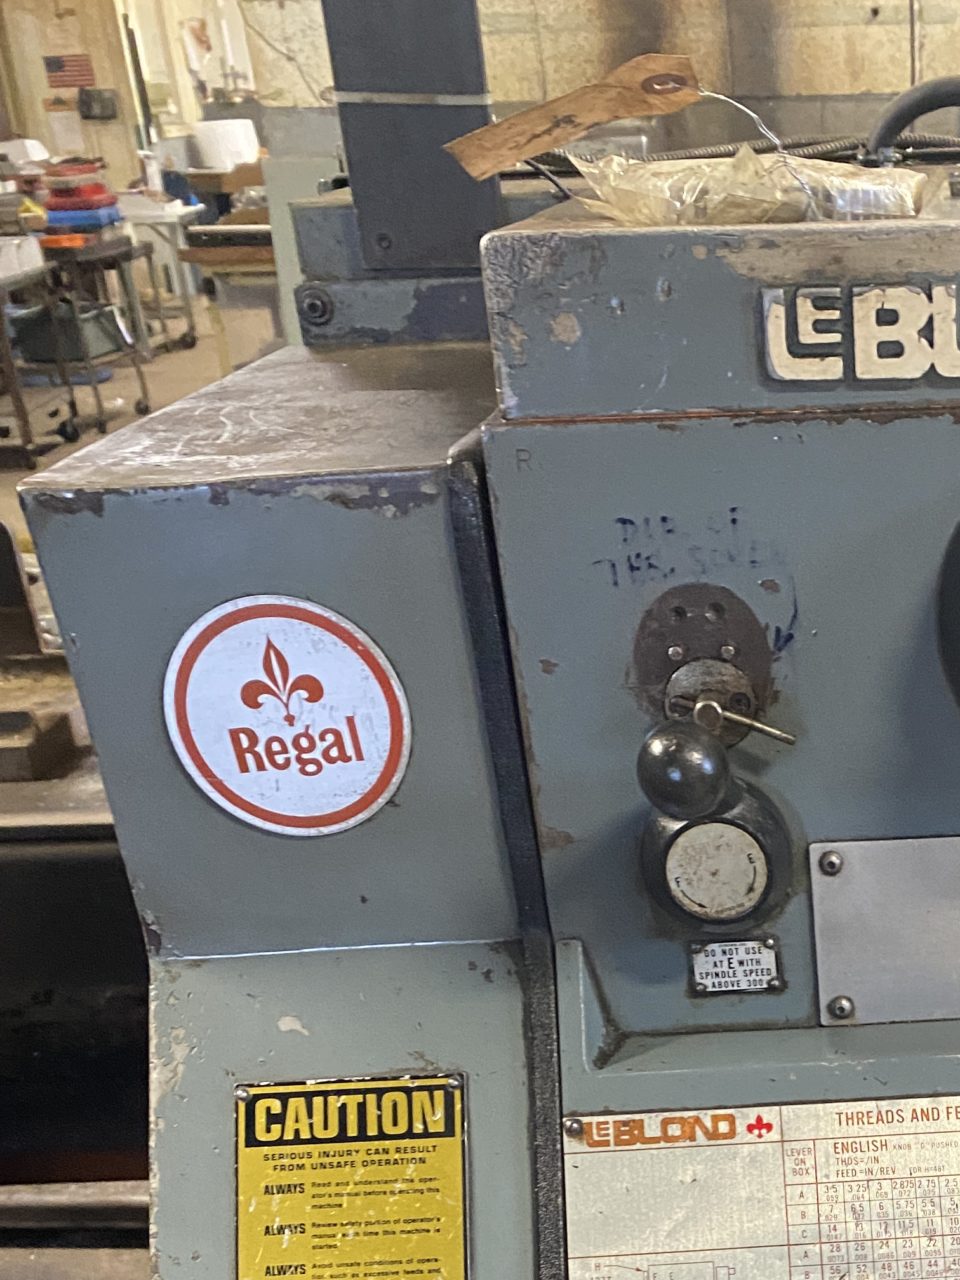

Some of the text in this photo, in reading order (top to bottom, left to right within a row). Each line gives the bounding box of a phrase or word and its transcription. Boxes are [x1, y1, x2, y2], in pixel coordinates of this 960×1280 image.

[516, 449, 532, 472] R
[228, 716, 364, 776] Regal
[704, 946, 762, 957] DO NOT USE
[713, 958, 761, 969] AT E WITH
[699, 968, 772, 980] SPINDLE SPEED
[711, 979, 763, 988] ABOVE 300
[254, 1090, 445, 1142] CAUTION
[836, 1109, 904, 1126] THREADS
[911, 1108, 940, 1122] AND
[786, 1148, 812, 1157] LEVER
[834, 1139, 888, 1154] ENGLISH
[264, 1152, 312, 1161] SERIOUS
[318, 1150, 359, 1158] INJURY
[273, 1158, 426, 1172] FROM UNSAFE OPERATION
[794, 1158, 806, 1166] ON
[792, 1168, 810, 1176] BOX
[264, 1183, 304, 1195] ALWAYS
[264, 1224, 305, 1236] ALWAYS
[830, 1244, 840, 1252] 28
[855, 1243, 865, 1251] 26
[879, 1240, 889, 1249] 24
[903, 1240, 913, 1248] 23
[927, 1239, 937, 1247] 22
[951, 1237, 960, 1245] 20
[265, 1264, 306, 1277] ALWAYS
